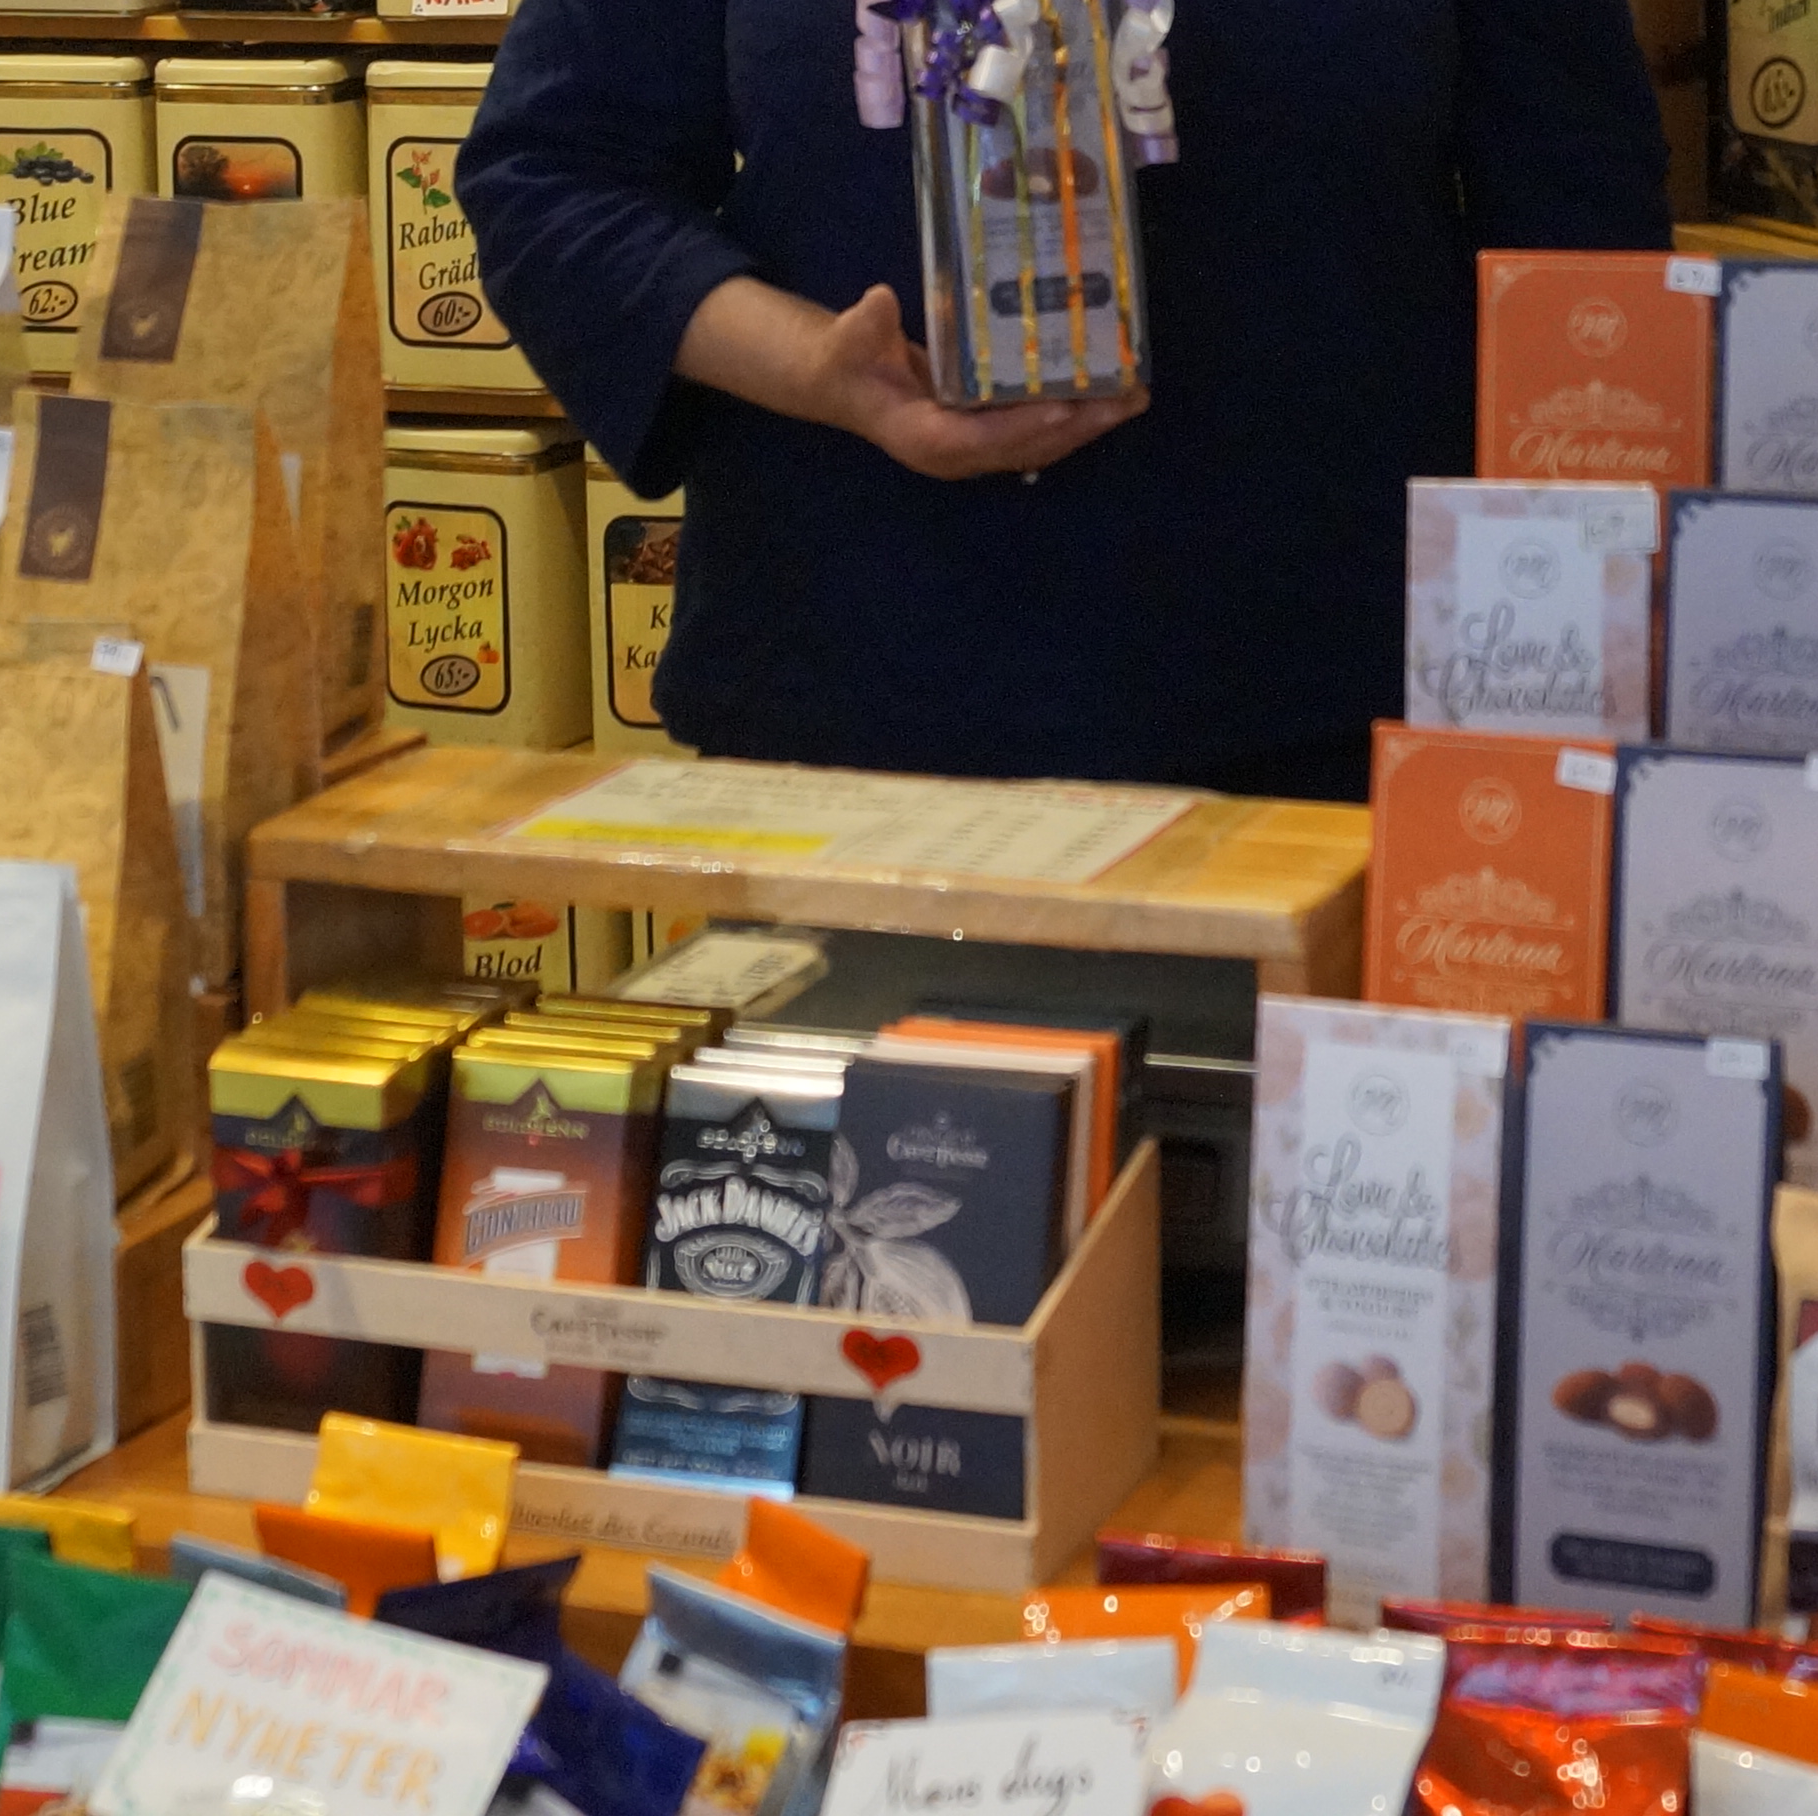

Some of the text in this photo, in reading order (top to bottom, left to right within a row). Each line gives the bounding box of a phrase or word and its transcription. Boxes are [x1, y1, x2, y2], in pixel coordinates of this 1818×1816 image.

[15, 243, 97, 275] ream
[29, 286, 69, 315] 62:-
[432, 298, 472, 328] 60:-
[396, 576, 495, 611] Morgon
[408, 619, 483, 652] Lycka
[435, 661, 470, 691] 65:-
[475, 945, 543, 979] Blod
[209, 1619, 454, 1725] SOMMAR
[175, 1687, 447, 1811] NYHETER
